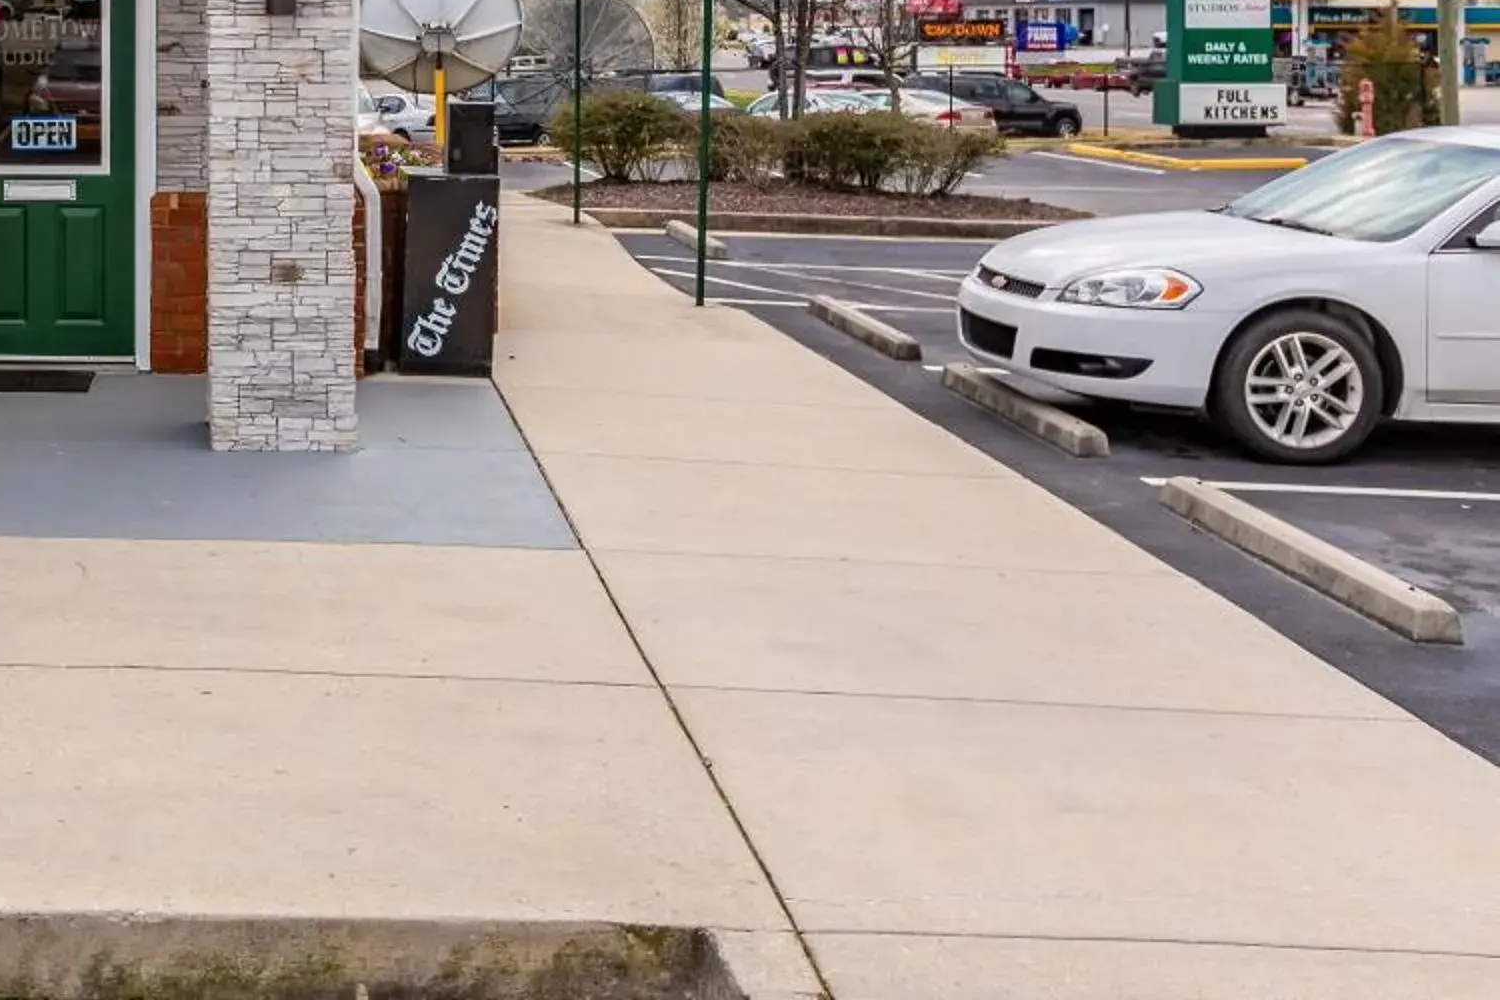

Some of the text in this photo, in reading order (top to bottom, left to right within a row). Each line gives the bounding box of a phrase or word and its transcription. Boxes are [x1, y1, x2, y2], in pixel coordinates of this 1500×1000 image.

[1187, 3, 1238, 13] STUDIOS
[1205, 41, 1247, 53] DAILY &
[1187, 53, 1269, 65] WEEKLY RATES
[1217, 89, 1251, 103] FULL
[1203, 106, 1278, 120] KITCHENS
[17, 121, 73, 146] OPEN
[407, 200, 498, 357] The Times
